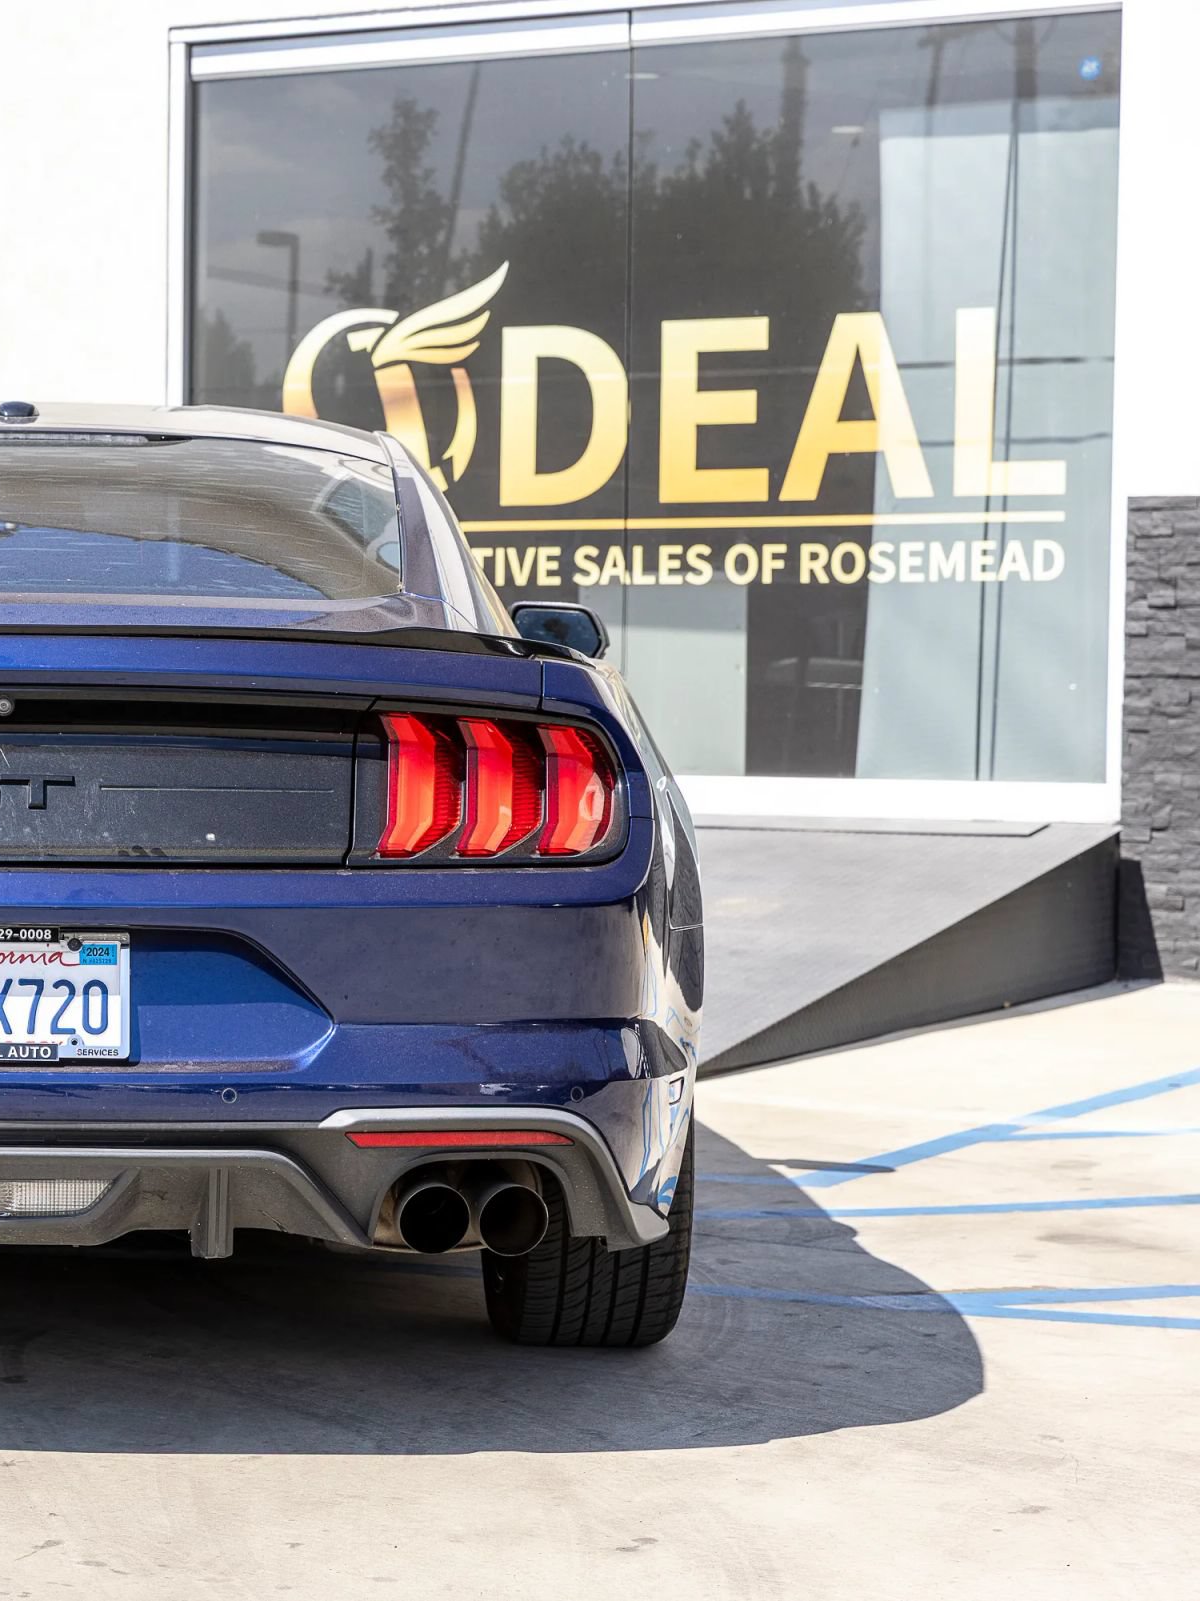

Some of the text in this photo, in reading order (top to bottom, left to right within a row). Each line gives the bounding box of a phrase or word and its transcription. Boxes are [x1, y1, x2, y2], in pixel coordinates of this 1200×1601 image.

[572, 543, 714, 586] SALES
[724, 543, 788, 586] OF
[799, 539, 1065, 584] ROSEMEAD
[86, 947, 110, 957] 2024
[7, 1045, 52, 1058] AUTO
[76, 1048, 119, 1056] SERVICES
